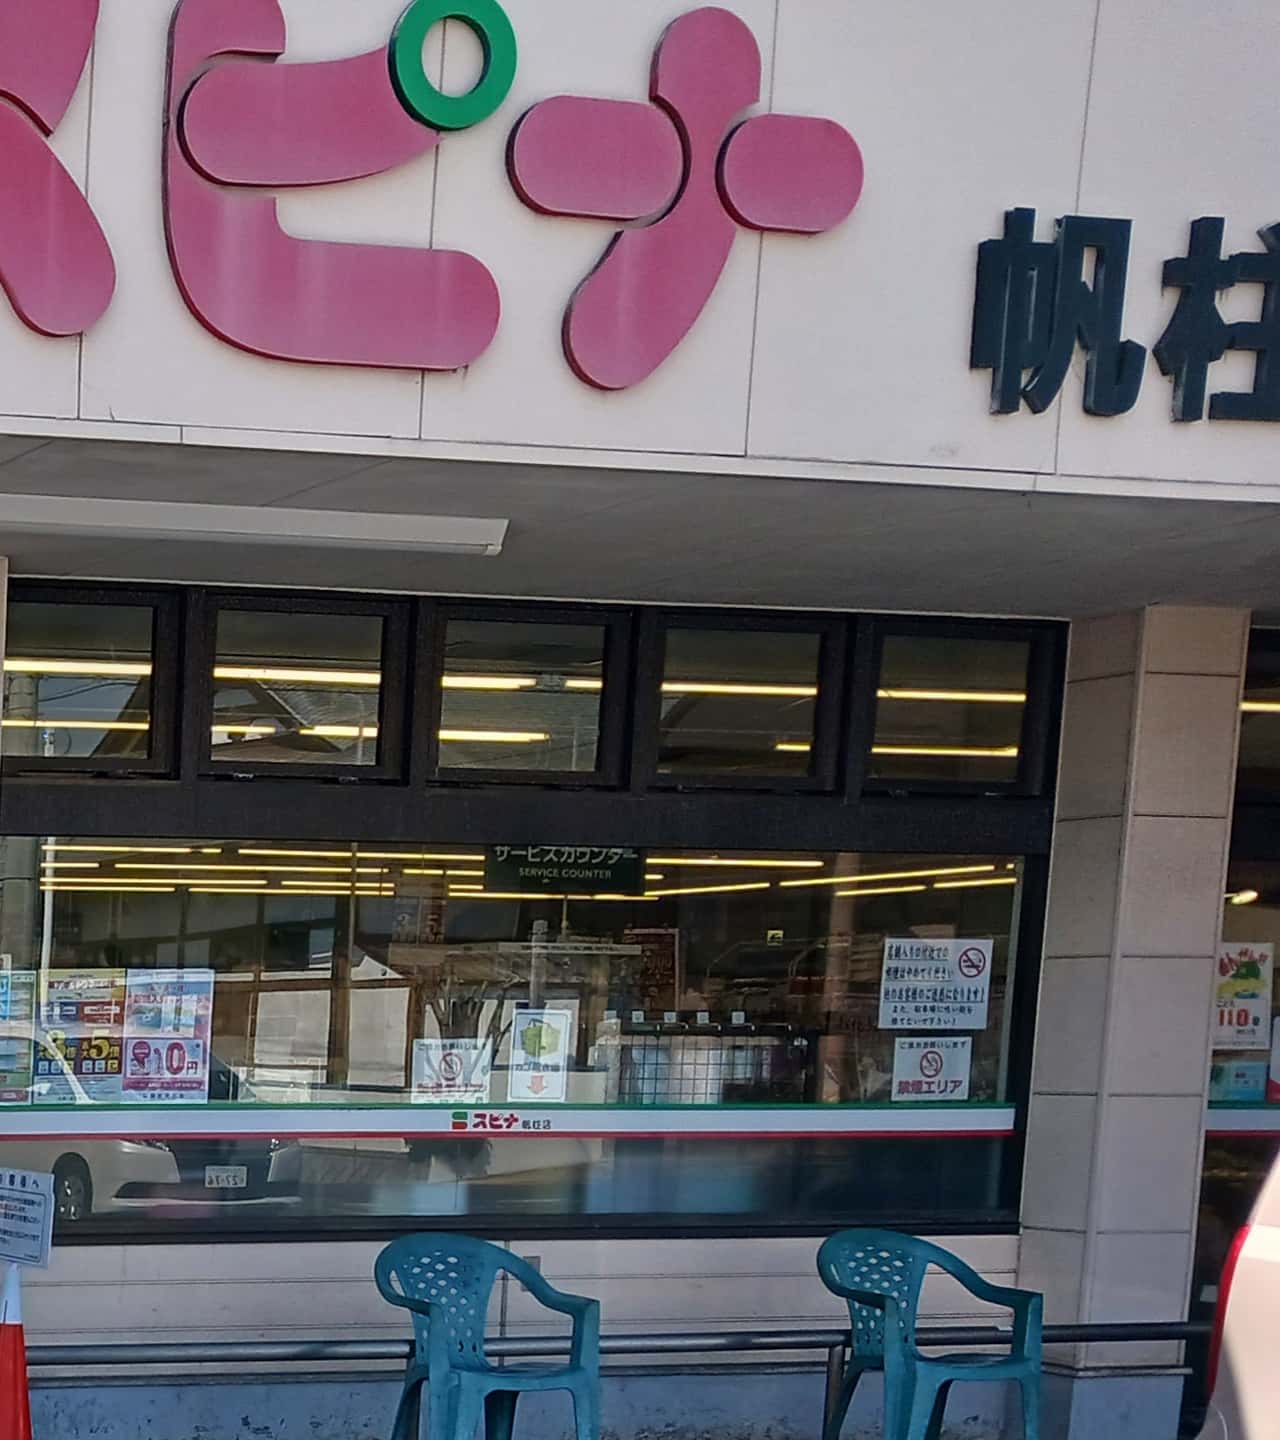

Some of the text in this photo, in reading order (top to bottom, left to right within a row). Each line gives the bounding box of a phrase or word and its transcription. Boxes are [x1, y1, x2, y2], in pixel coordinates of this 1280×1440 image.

[970, 207, 1280, 422] 帆柱
[493, 845, 639, 864] サービスカウンター
[519, 867, 612, 879] SERVICE COUNTER
[472, 1113, 519, 1129] スピナ
